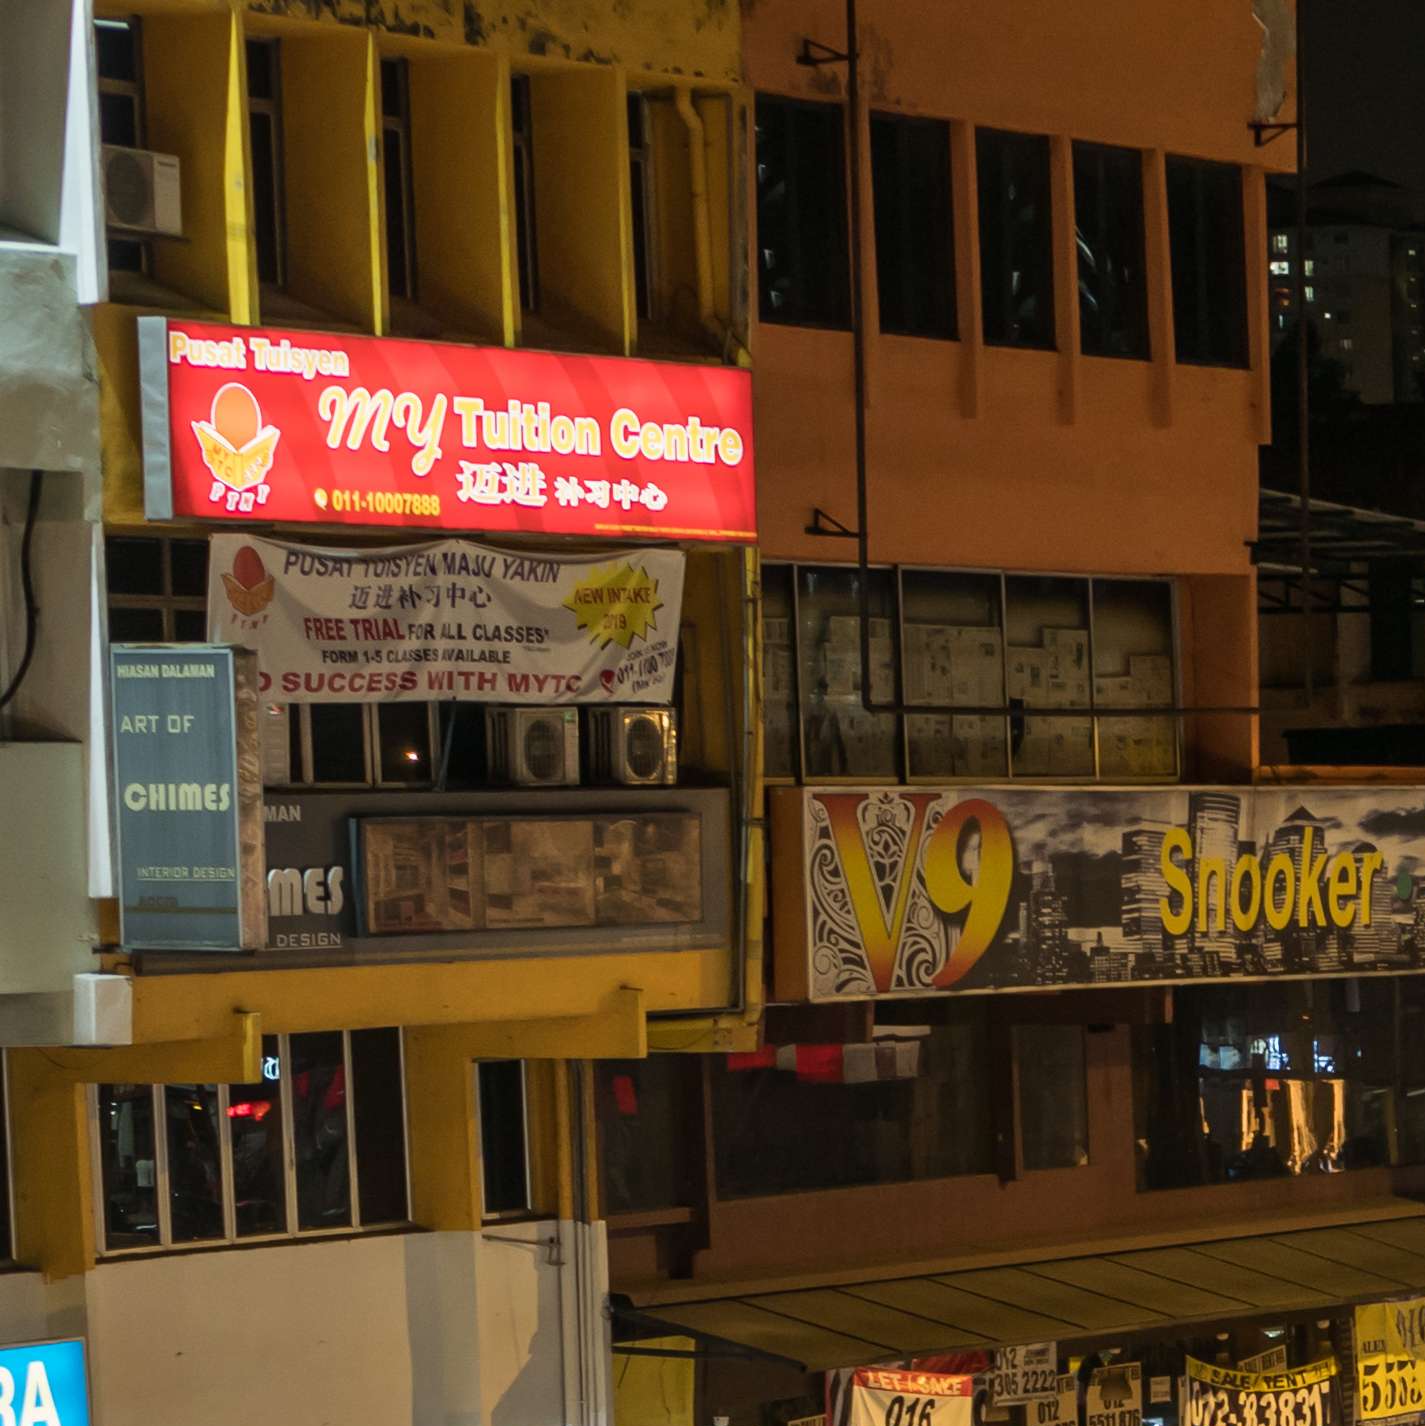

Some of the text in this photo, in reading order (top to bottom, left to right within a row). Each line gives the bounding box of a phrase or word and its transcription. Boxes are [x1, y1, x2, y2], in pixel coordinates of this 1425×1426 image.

[169, 331, 350, 380] Pusat Tuisyen
[453, 396, 601, 456] Tuition
[610, 408, 743, 466] Centre
[455, 460, 668, 511] 迈进 补习中心
[333, 490, 440, 516] 011-10007888
[442, 552, 496, 578] MAJU
[503, 558, 560, 583] YAKIN
[350, 582, 492, 609] 迈进补习中心
[304, 616, 467, 641] FREE TRIAL FOR ALL
[322, 649, 511, 664] FORM 1-5 CLASSES AVAILABLE
[282, 670, 582, 694] SUCCESS WITH MYTC
[120, 715, 194, 734] ART OF
[124, 783, 231, 812] CHIMES
[812, 792, 1014, 994] V9
[1158, 826, 1385, 936] Snooker
[276, 932, 342, 947] DESIGN
[1038, 1401, 1059, 1424] 012
